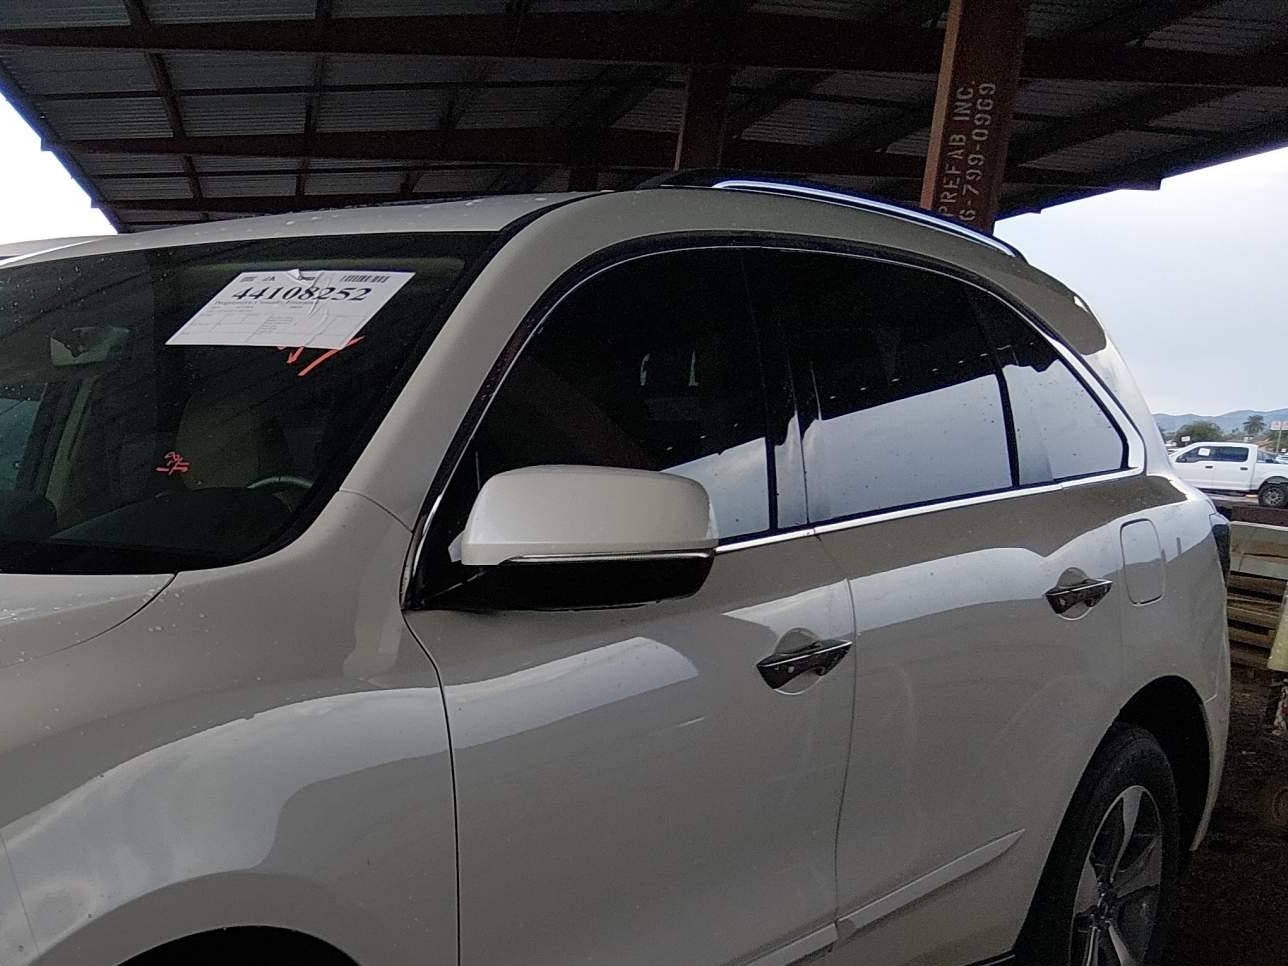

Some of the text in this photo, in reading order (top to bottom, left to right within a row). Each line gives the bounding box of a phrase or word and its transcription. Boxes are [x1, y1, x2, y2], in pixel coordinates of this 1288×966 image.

[938, 80, 976, 217] PREFAB INC.
[232, 286, 372, 302] 44108252
